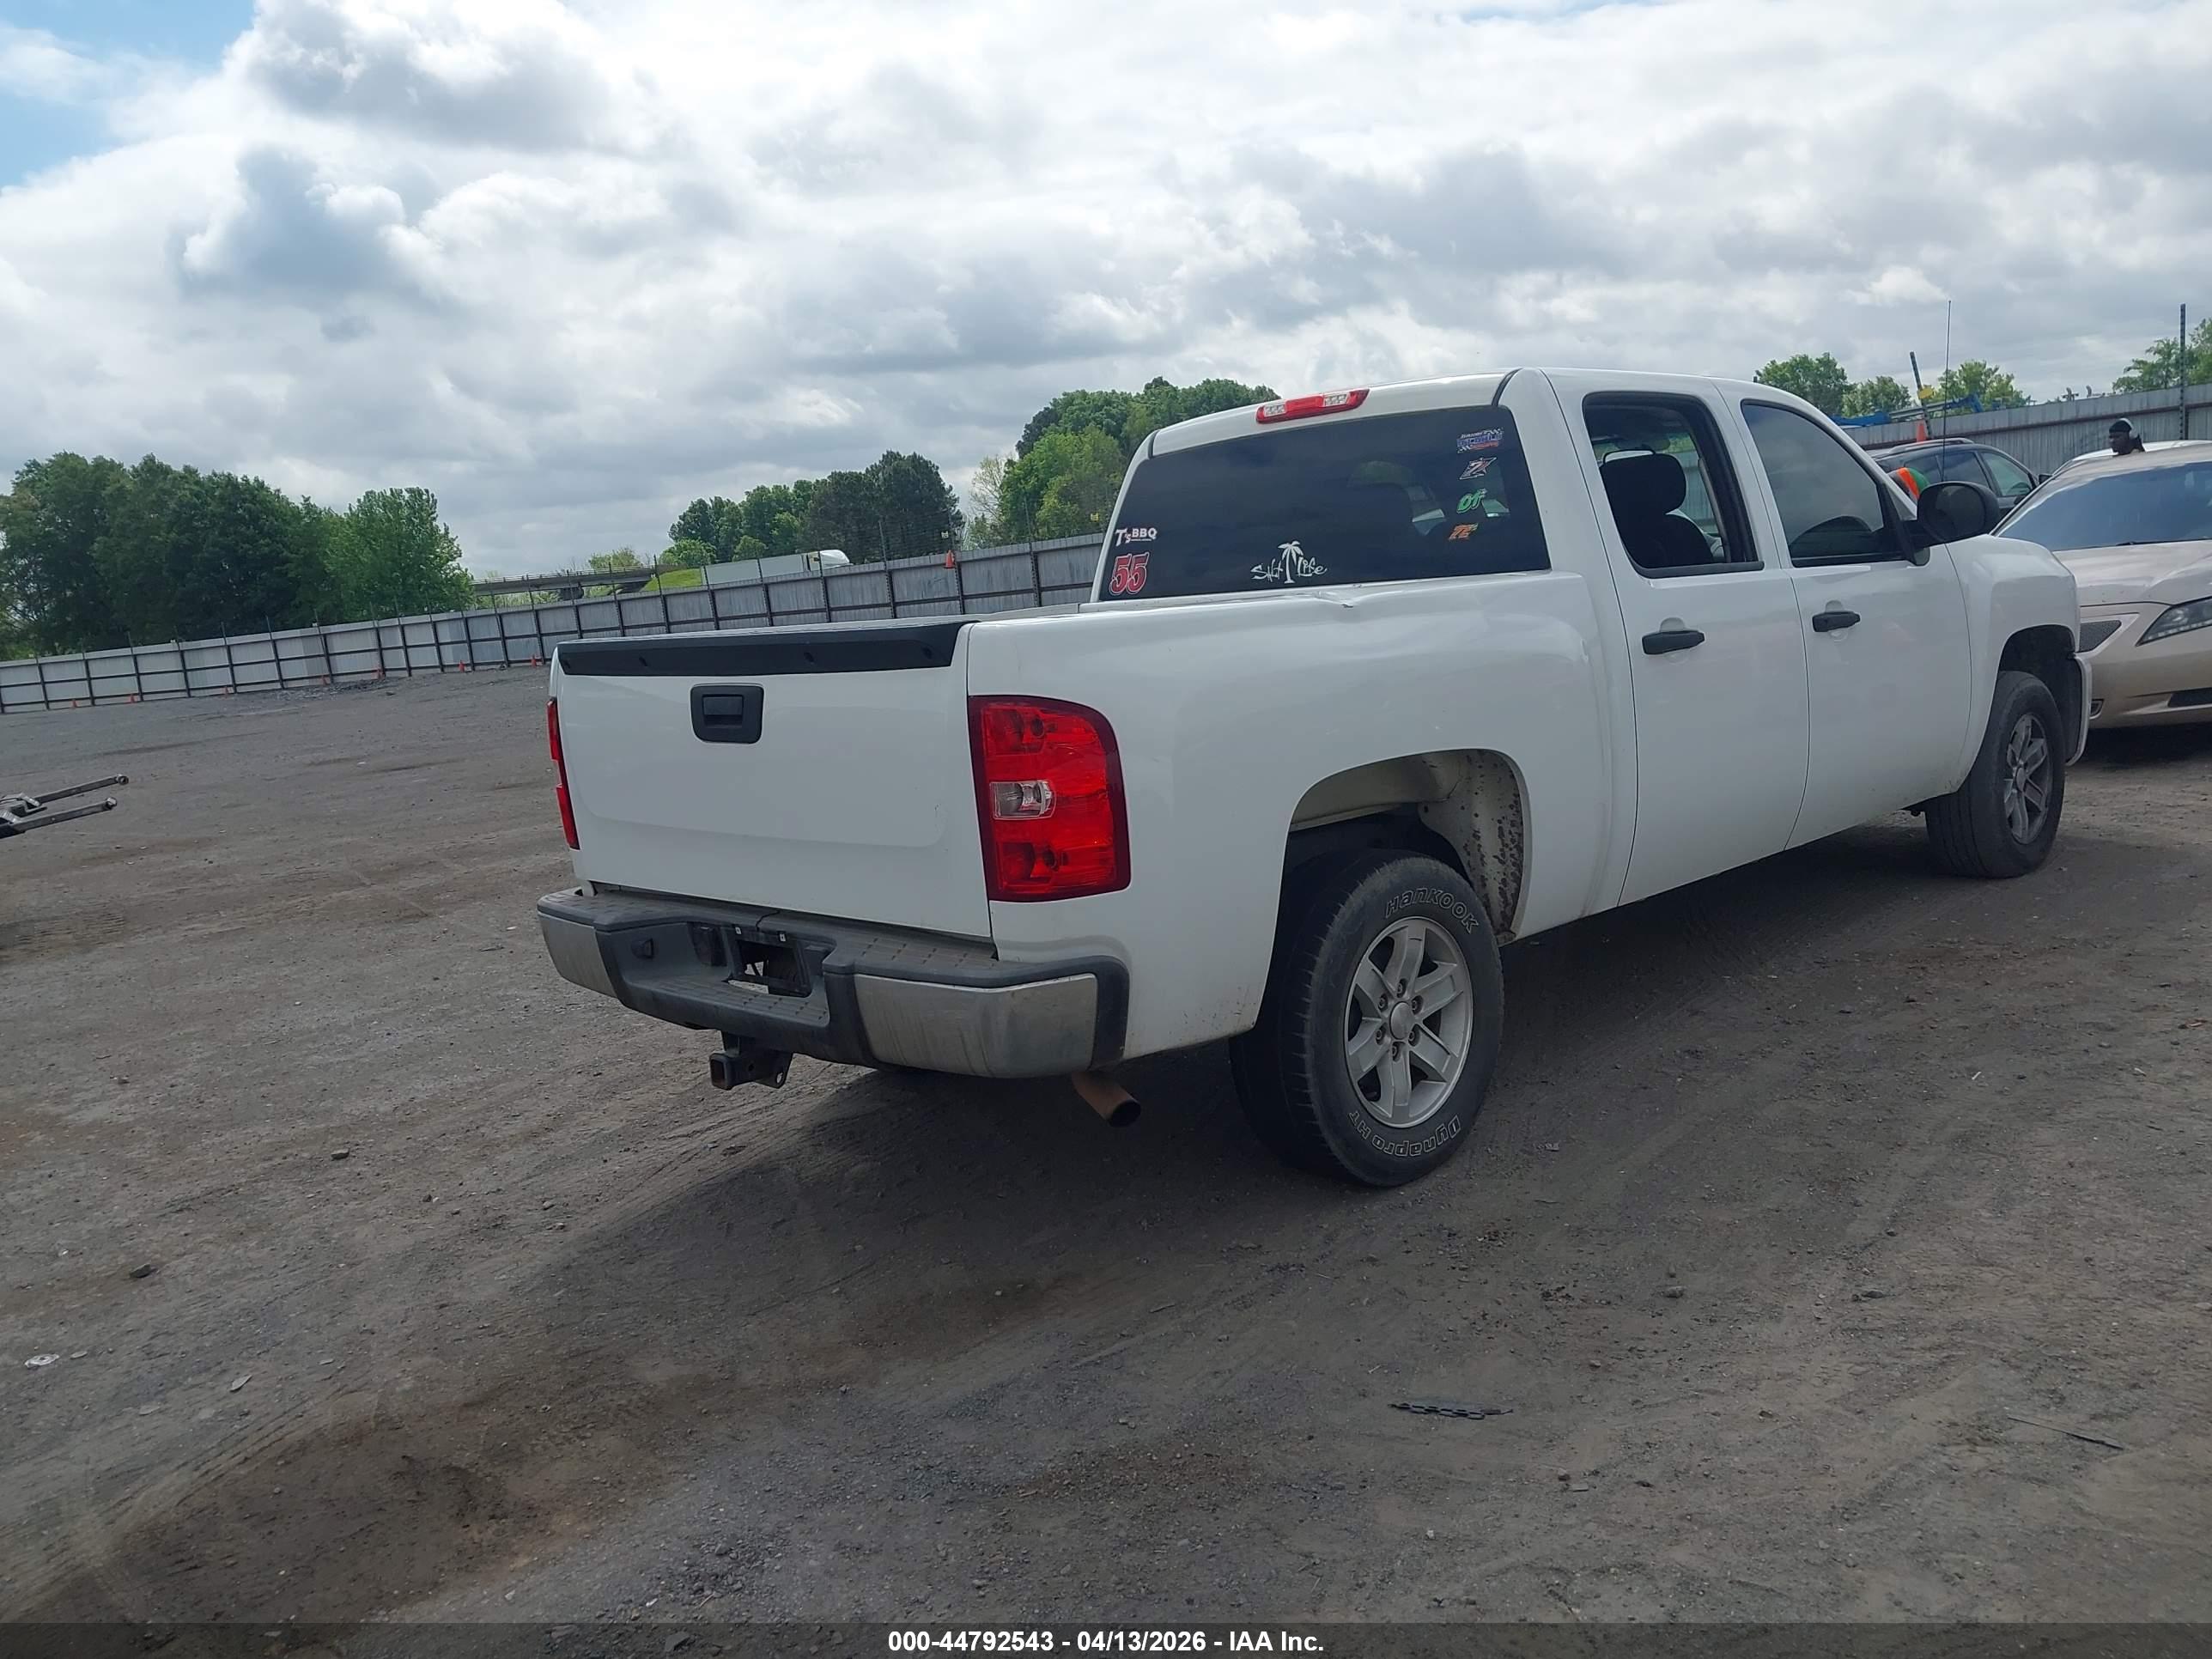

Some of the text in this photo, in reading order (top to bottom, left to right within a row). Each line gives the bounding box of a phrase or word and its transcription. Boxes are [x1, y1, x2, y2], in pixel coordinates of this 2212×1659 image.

[1132, 527, 1158, 540] BBQ
[1109, 551, 1150, 596] 55
[1372, 1115, 1461, 1157] Dynapro
